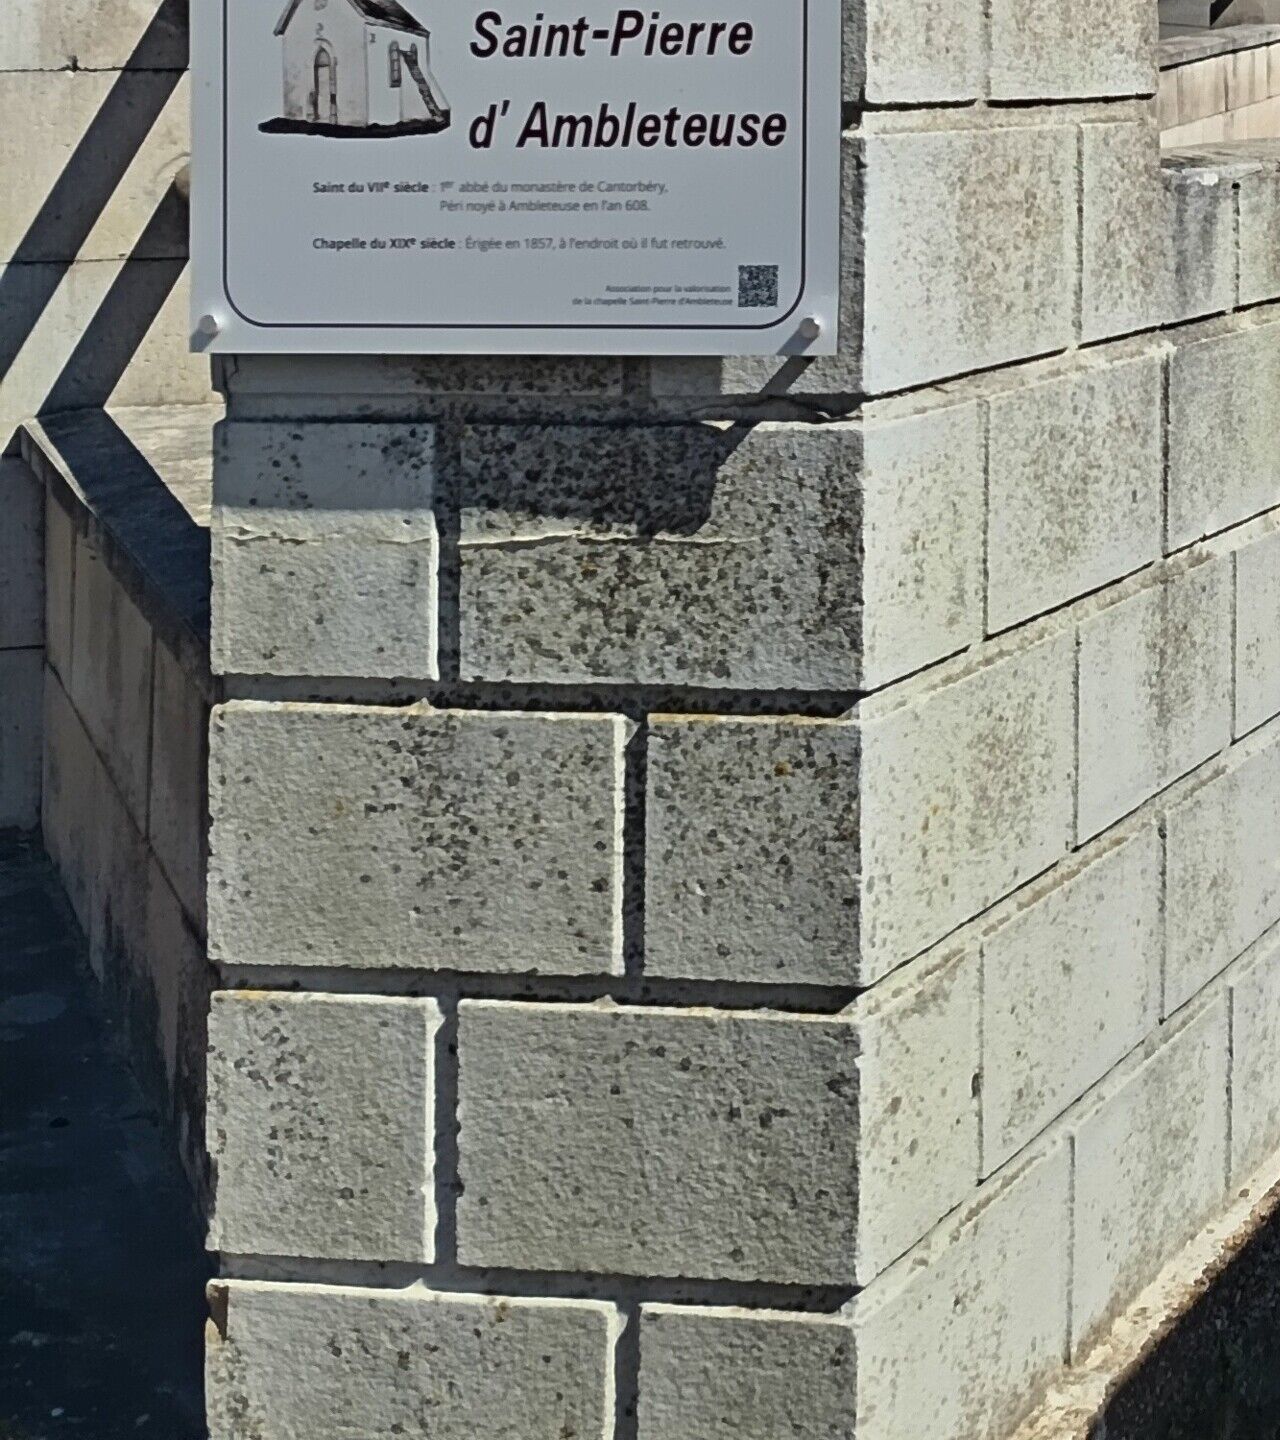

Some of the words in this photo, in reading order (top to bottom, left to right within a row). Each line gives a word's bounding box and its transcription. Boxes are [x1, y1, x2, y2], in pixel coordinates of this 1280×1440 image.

[469, 8, 754, 59] Saint-Pierre
[313, 182, 344, 193] Saint
[348, 182, 364, 193] du
[394, 182, 429, 193] siècle
[459, 181, 488, 192] abbé
[492, 181, 508, 192] du
[511, 181, 576, 192] monastère
[579, 181, 594, 192] de
[440, 200, 463, 211] Péri
[467, 200, 495, 214] noyé
[499, 201, 506, 211] à
[509, 200, 580, 211] Ambleteuse
[583, 202, 598, 210] en
[601, 200, 622, 210] l'an
[313, 238, 367, 252] Chapelle
[370, 238, 386, 249] du
[420, 238, 456, 249] siècle
[505, 240, 520, 249] en
[559, 238, 566, 249] à
[569, 238, 619, 249] l'endroit
[622, 238, 638, 249] où
[641, 238, 647, 249] il
[650, 237, 668, 249] fut
